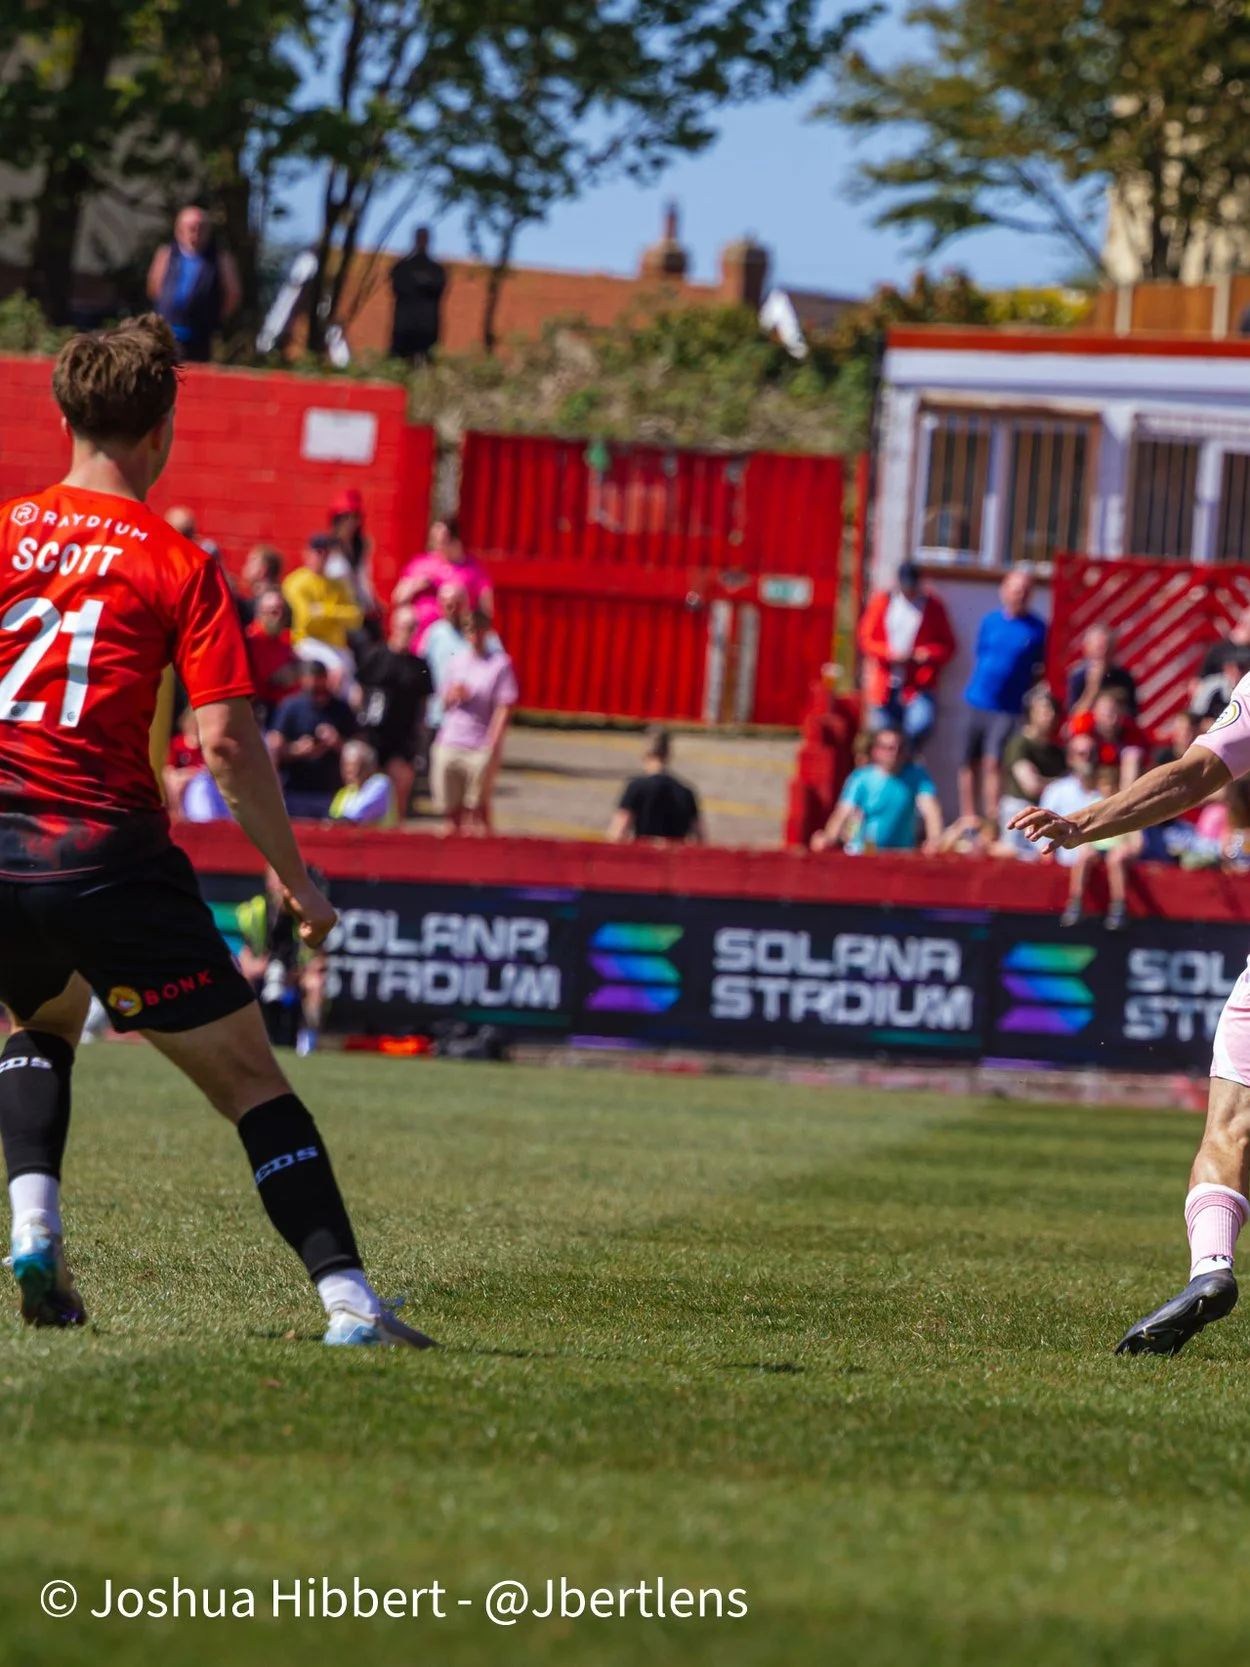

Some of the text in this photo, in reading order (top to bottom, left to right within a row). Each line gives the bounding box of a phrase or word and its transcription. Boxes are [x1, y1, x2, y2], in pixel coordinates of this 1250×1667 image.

[43, 511, 149, 541] RAYDIUM
[12, 537, 123, 576] SCOTT
[0, 597, 104, 728] 21
[712, 927, 962, 982] SOLANA
[143, 970, 213, 1006] BONK
[710, 974, 973, 1031] STADIUM
